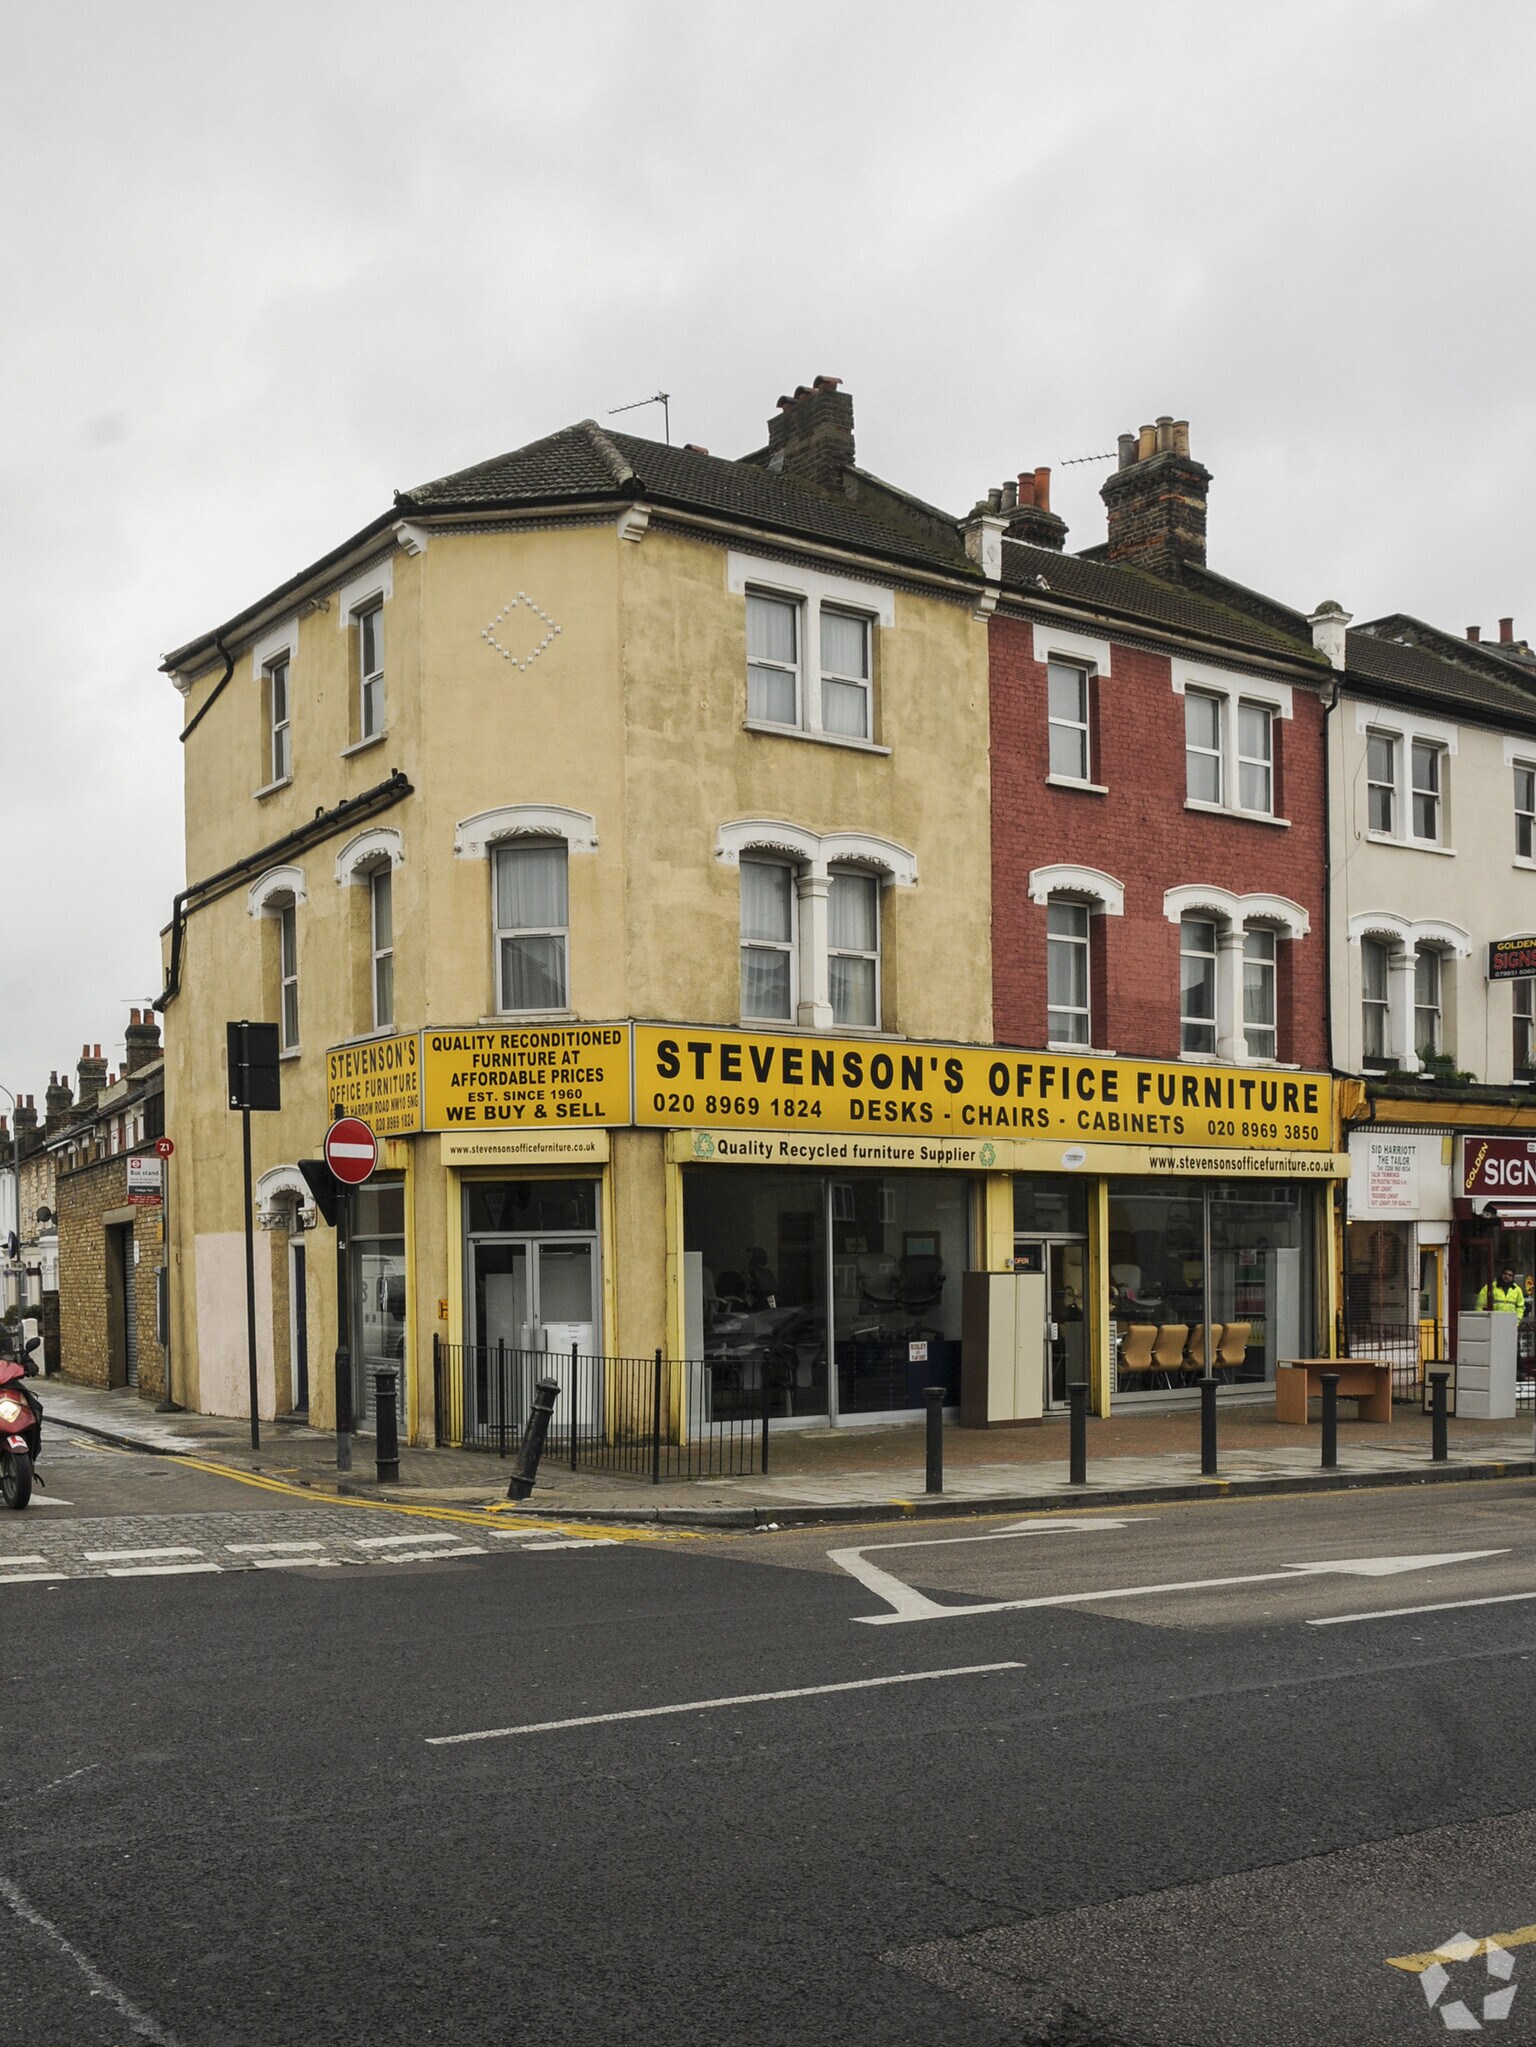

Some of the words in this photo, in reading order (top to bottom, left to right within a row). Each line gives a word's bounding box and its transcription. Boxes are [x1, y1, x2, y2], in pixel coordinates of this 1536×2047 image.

[1497, 939, 1536, 951] GOLDEN
[432, 1035, 495, 1051] QUALITY
[501, 1030, 622, 1049] RECONDITIONED
[331, 1039, 415, 1080] STEVENSON'S
[473, 1051, 556, 1068] FURNITURE
[561, 1050, 580, 1065] AT
[657, 1040, 964, 1094] STEVENSON'S
[451, 1070, 546, 1087] AFFORDABLE
[551, 1067, 604, 1084] PRICES
[330, 1081, 361, 1104] OFFICE
[365, 1071, 417, 1098] FURNITURE
[468, 1091, 498, 1102] EST.
[503, 1090, 545, 1101] SINCE
[550, 1088, 582, 1100] 1960
[989, 1062, 1119, 1101] OFFICE
[1137, 1072, 1319, 1114] FURNITURE
[350, 1102, 373, 1117] HARROW
[375, 1099, 389, 1114] ROAD
[446, 1106, 476, 1121] WE
[484, 1104, 525, 1120] BUY
[534, 1103, 547, 1119] &
[556, 1102, 606, 1117] SELL
[653, 1092, 695, 1113] 020
[705, 1095, 760, 1115] 8969
[770, 1097, 822, 1118] 1824
[850, 1099, 934, 1123] DESKS
[961, 1105, 1050, 1129] CHAIRS
[1078, 1109, 1185, 1135] CABINETS
[1208, 1119, 1235, 1137] 020
[1241, 1121, 1277, 1139] 8969
[1284, 1123, 1319, 1141] 3850
[160, 1143, 170, 1151] Z1
[450, 1141, 596, 1155] www.stevensonsofficefurniture.co.uk
[718, 1139, 773, 1159] Quality
[779, 1140, 848, 1159] Recycled
[852, 1143, 915, 1160] furniture
[920, 1146, 976, 1164] Supplier
[1371, 1144, 1382, 1154] SID
[1149, 1154, 1335, 1173] www.stevensonsofficefurniture.co.uk
[1378, 1155, 1389, 1165] THE
[1391, 1156, 1410, 1165] TAILOR
[1465, 1142, 1489, 1188] GOLDEN
[1014, 1257, 1029, 1265] OPEN
